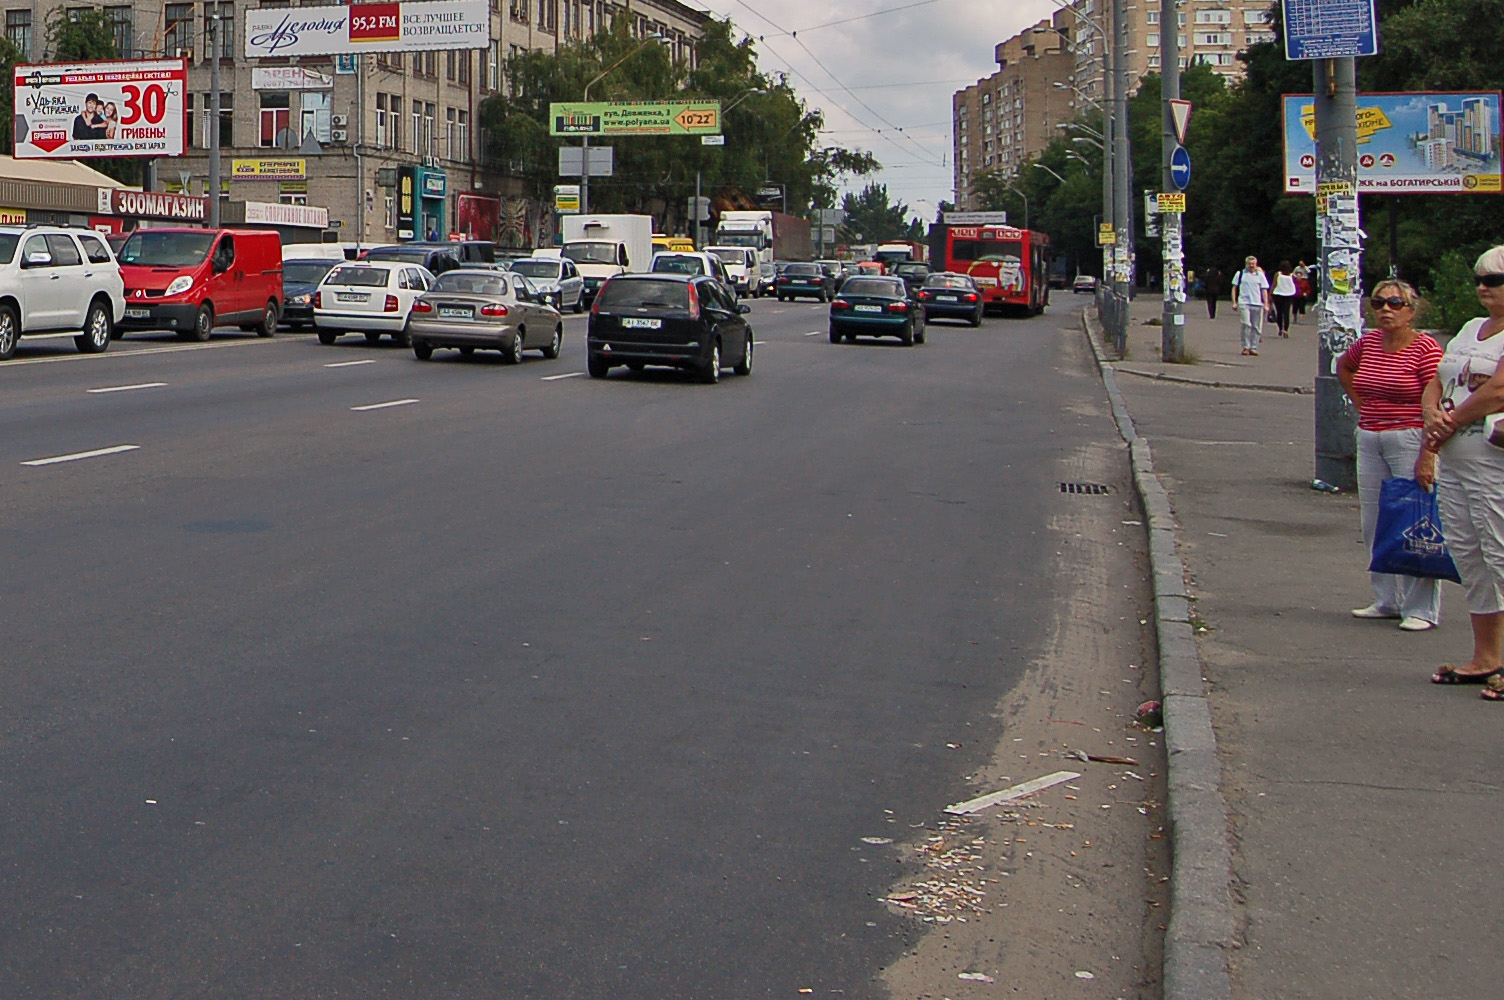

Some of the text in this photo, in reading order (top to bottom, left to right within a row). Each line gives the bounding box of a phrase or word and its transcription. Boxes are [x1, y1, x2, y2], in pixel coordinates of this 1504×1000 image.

[352, 15, 396, 31] 95,2 FM
[403, 12, 464, 24] ВСЕ ЛУЧШЕЕ
[403, 22, 486, 36] ВОЗВРАЩАЕТСЯ!
[120, 84, 166, 125] 30
[121, 127, 166, 140] ГРИВЕНЬ!
[1390, 178, 1460, 186] БОГАТИРСЬКІЙ
[118, 192, 204, 218] ЗООМАГАЗИН
